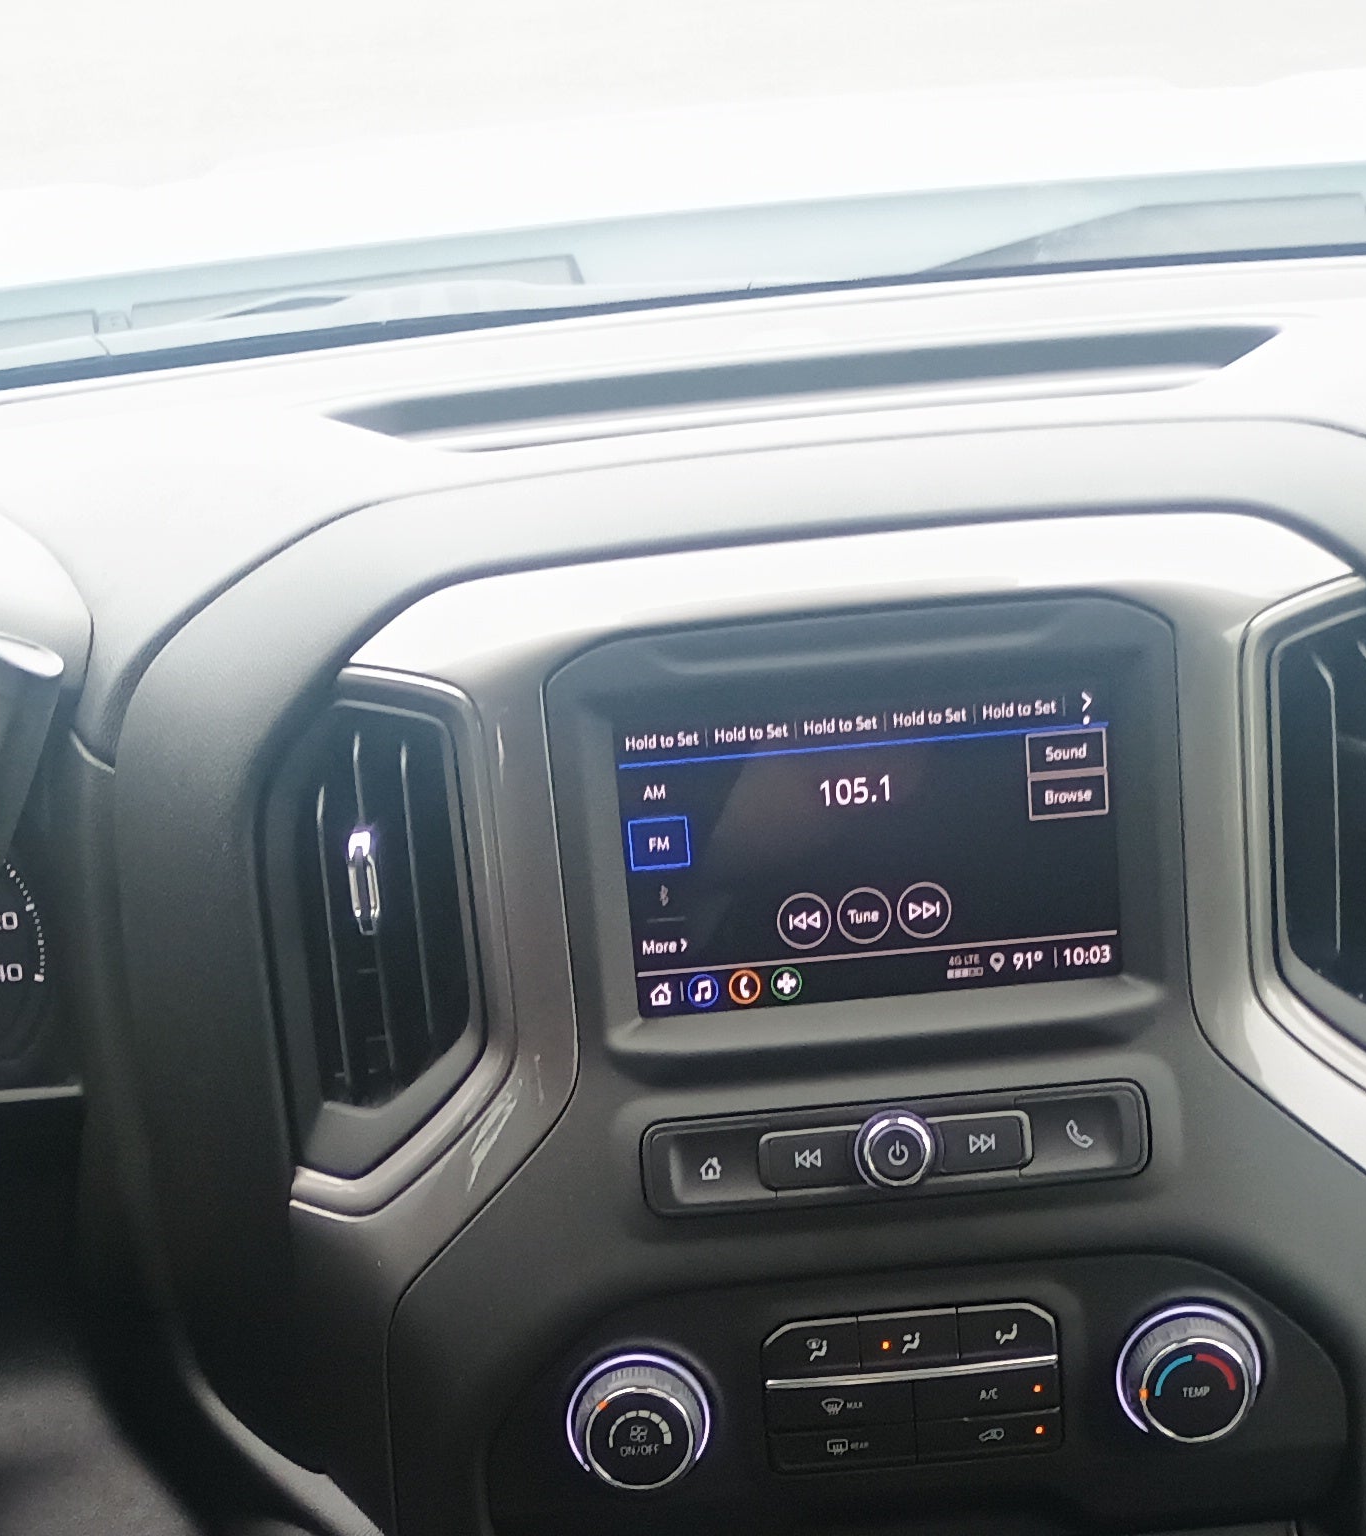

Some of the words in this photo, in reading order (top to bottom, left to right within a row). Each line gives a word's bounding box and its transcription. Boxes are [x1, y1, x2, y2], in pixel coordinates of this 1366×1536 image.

[893, 710, 925, 728] Hold
[928, 711, 942, 725] to
[945, 707, 967, 723] Set
[983, 702, 1015, 720] Hold
[1018, 703, 1031, 717] to
[1035, 700, 1057, 715] Set
[714, 726, 746, 744] Hold
[750, 726, 763, 741] to
[767, 722, 789, 739] Set
[803, 718, 835, 736] Hold
[839, 718, 853, 733] to
[855, 715, 877, 731] Set
[625, 734, 657, 752] Hold
[660, 735, 674, 749] to
[677, 731, 700, 748] Set
[1045, 743, 1088, 763] Sound
[643, 783, 667, 801] AM
[819, 774, 891, 807] 105.1
[1044, 789, 1093, 806] Browse
[648, 835, 670, 853] FM
[847, 908, 880, 926] Tune
[642, 938, 678, 956] More
[1063, 944, 1112, 967] 10:03
[1182, 1386, 1211, 1398] TEMP
